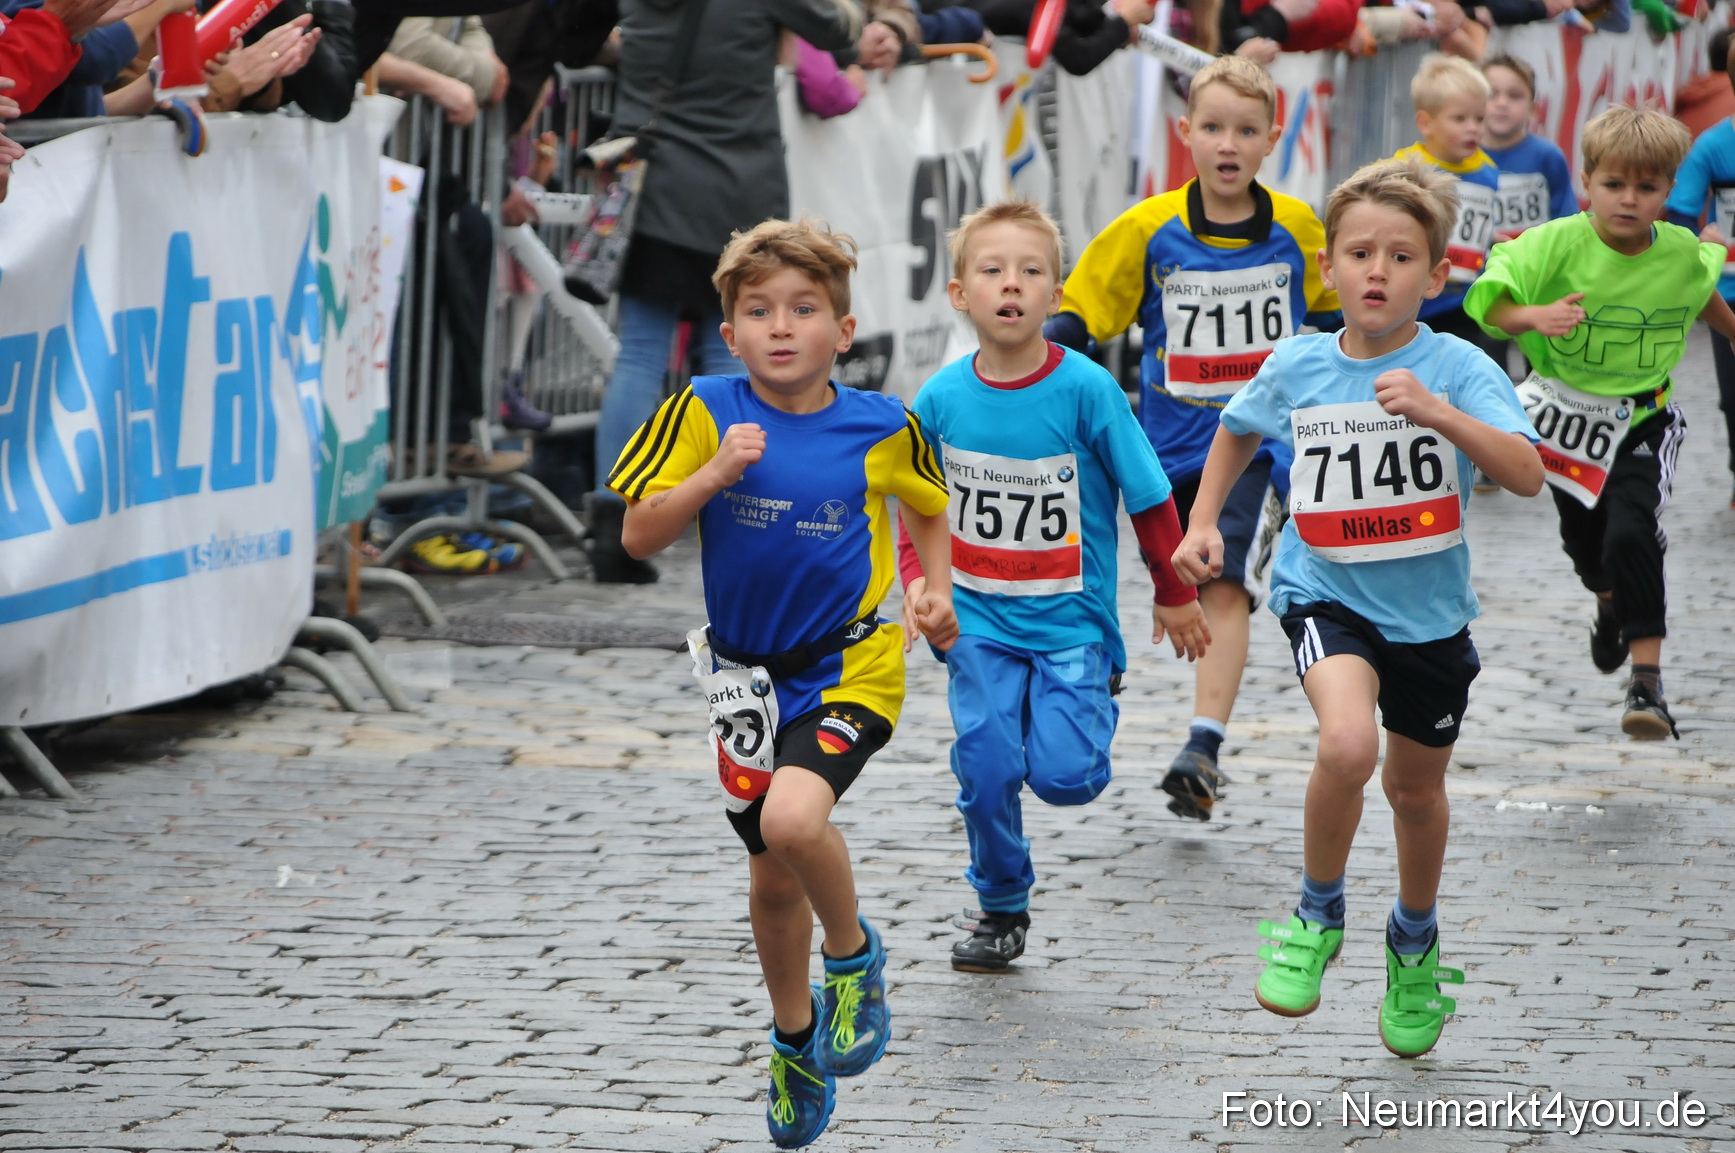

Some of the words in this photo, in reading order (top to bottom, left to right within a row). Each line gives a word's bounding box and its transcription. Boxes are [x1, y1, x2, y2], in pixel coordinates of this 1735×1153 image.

[229, 1, 269, 40] Audi
[1166, 284, 1207, 297] PARTL
[1212, 280, 1272, 296] Neumarkt
[1177, 296, 1282, 348] 7116
[1199, 357, 1265, 379] Samue
[1297, 422, 1340, 439] PARTL
[1344, 419, 1415, 434] Neumark
[944, 456, 980, 480] PARTL
[983, 468, 1052, 486] Neumarkt
[1304, 435, 1443, 503] 7146
[1445, 482, 1453, 493] K
[731, 504, 779, 522] LANGE
[953, 481, 1068, 542] 7575
[1296, 501, 1302, 511] 2
[735, 517, 767, 529] AMBERG
[796, 520, 843, 532] GRAMMER
[1341, 515, 1413, 540] Niklas
[704, 685, 744, 707] arkt
[822, 719, 858, 739] GERMANY
[759, 757, 766, 768] K
